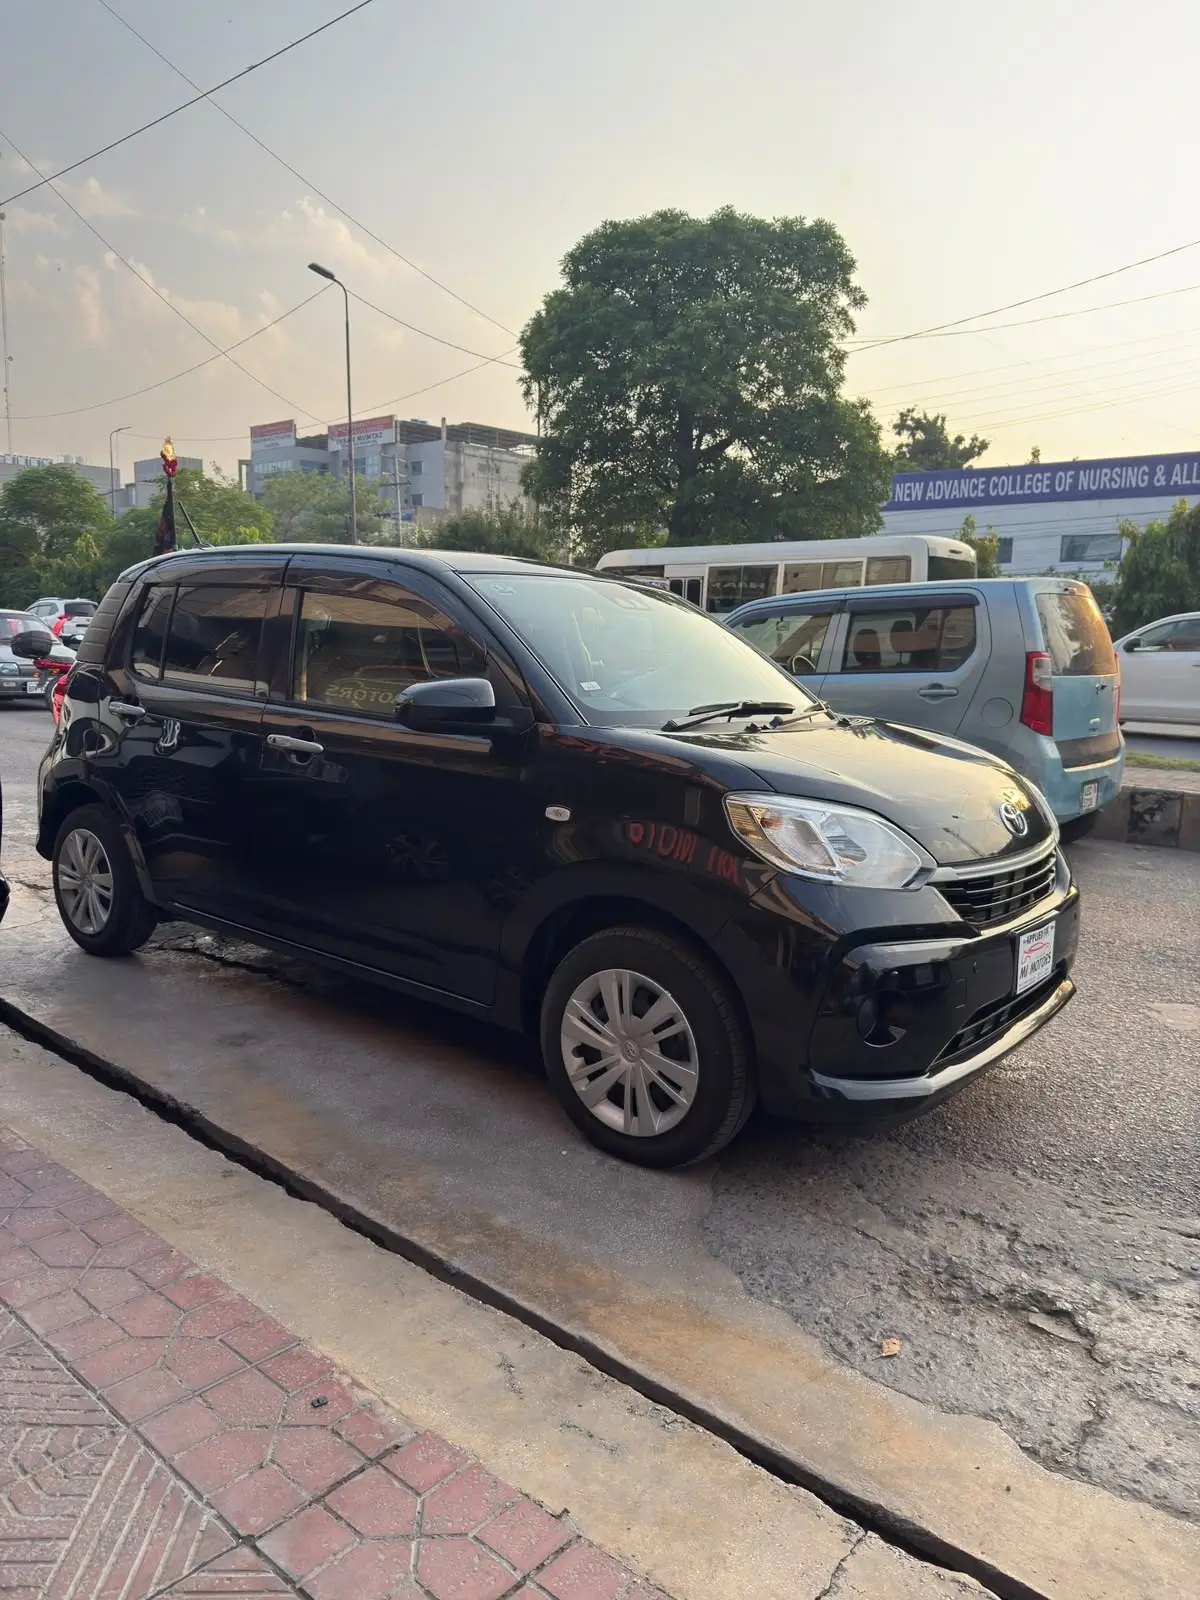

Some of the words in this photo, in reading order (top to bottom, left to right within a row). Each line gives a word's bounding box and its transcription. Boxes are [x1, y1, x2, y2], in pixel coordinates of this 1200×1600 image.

[894, 481, 924, 502] NEW
[926, 476, 986, 500] ADVANCE
[989, 471, 1052, 496] COLLEGE
[1055, 470, 1075, 492] OF
[1078, 465, 1149, 491] NURSING
[1154, 464, 1167, 487] &
[1030, 951, 1051, 973] MOTORS
